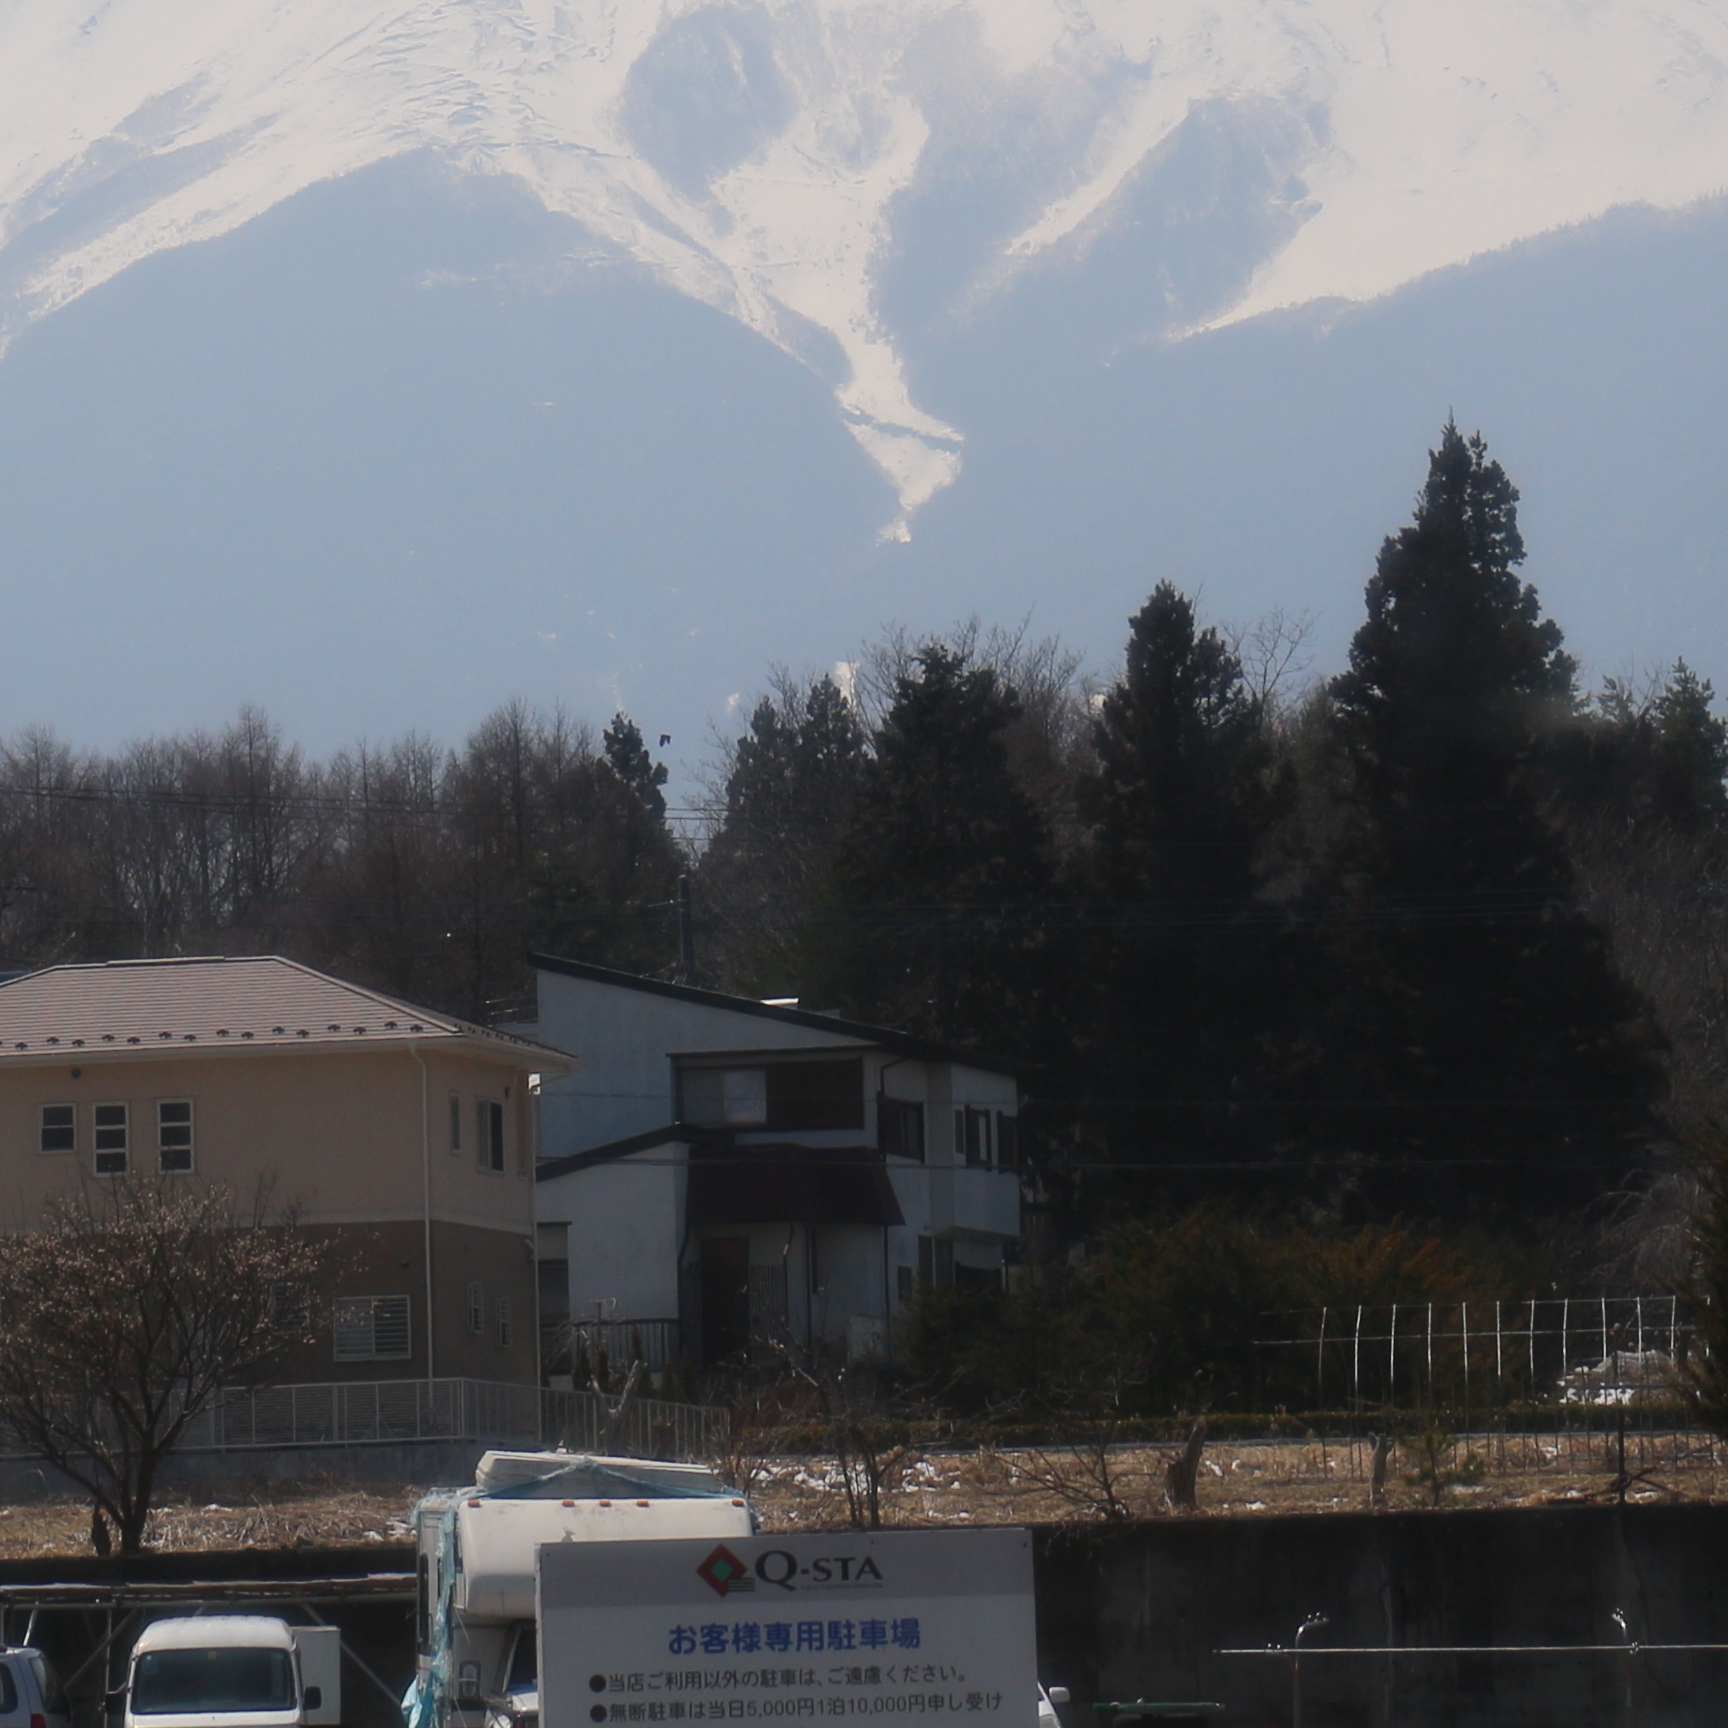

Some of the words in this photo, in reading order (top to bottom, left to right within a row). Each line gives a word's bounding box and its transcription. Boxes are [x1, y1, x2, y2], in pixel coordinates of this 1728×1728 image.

[755, 1549, 883, 1591] Q-STA
[668, 1618, 921, 1654] お客様専用駐車場
